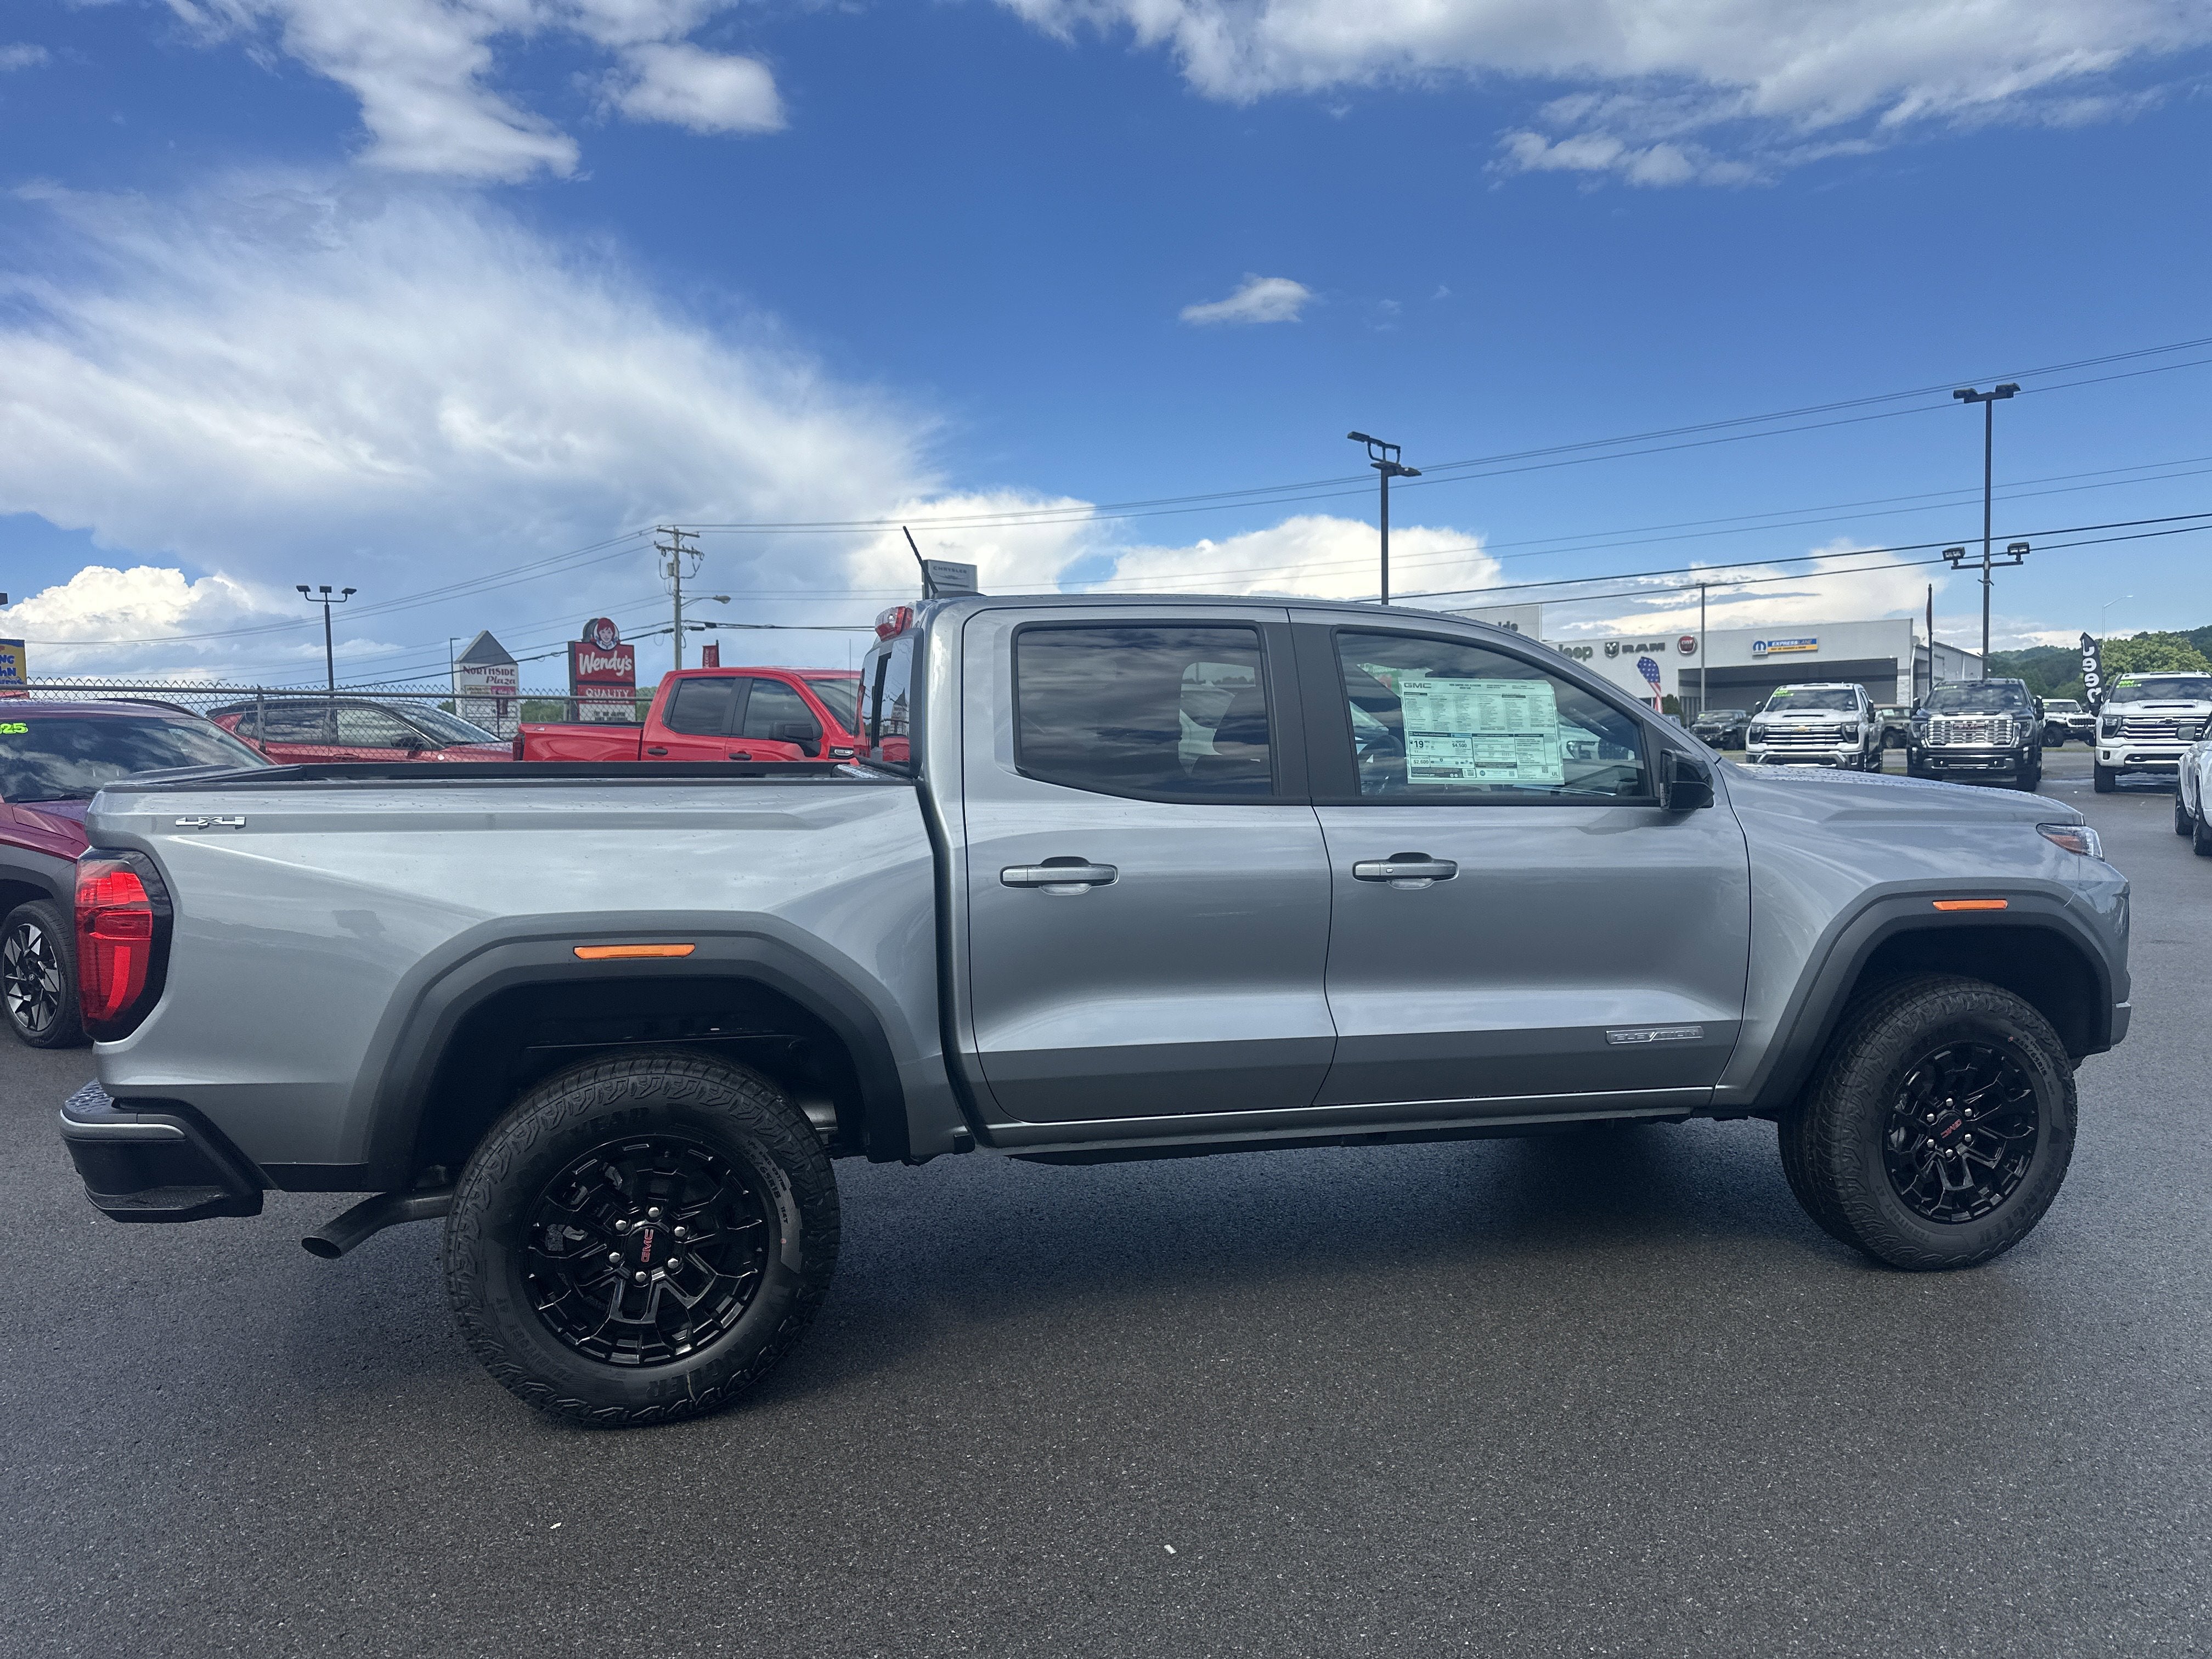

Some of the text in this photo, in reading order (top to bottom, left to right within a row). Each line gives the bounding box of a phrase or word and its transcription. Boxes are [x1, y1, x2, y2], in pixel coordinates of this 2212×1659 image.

[933, 566, 967, 574] CHRYSLER
[1622, 642, 1666, 654] RAM
[579, 650, 632, 676] Wendy's
[463, 665, 515, 676] NORTHSIDE
[486, 675, 515, 685] Plaza
[586, 687, 629, 698] QUALITY
[0, 723, 28, 733] 25
[1940, 1119, 1962, 1138] GMC
[641, 1228, 654, 1262] GMC
